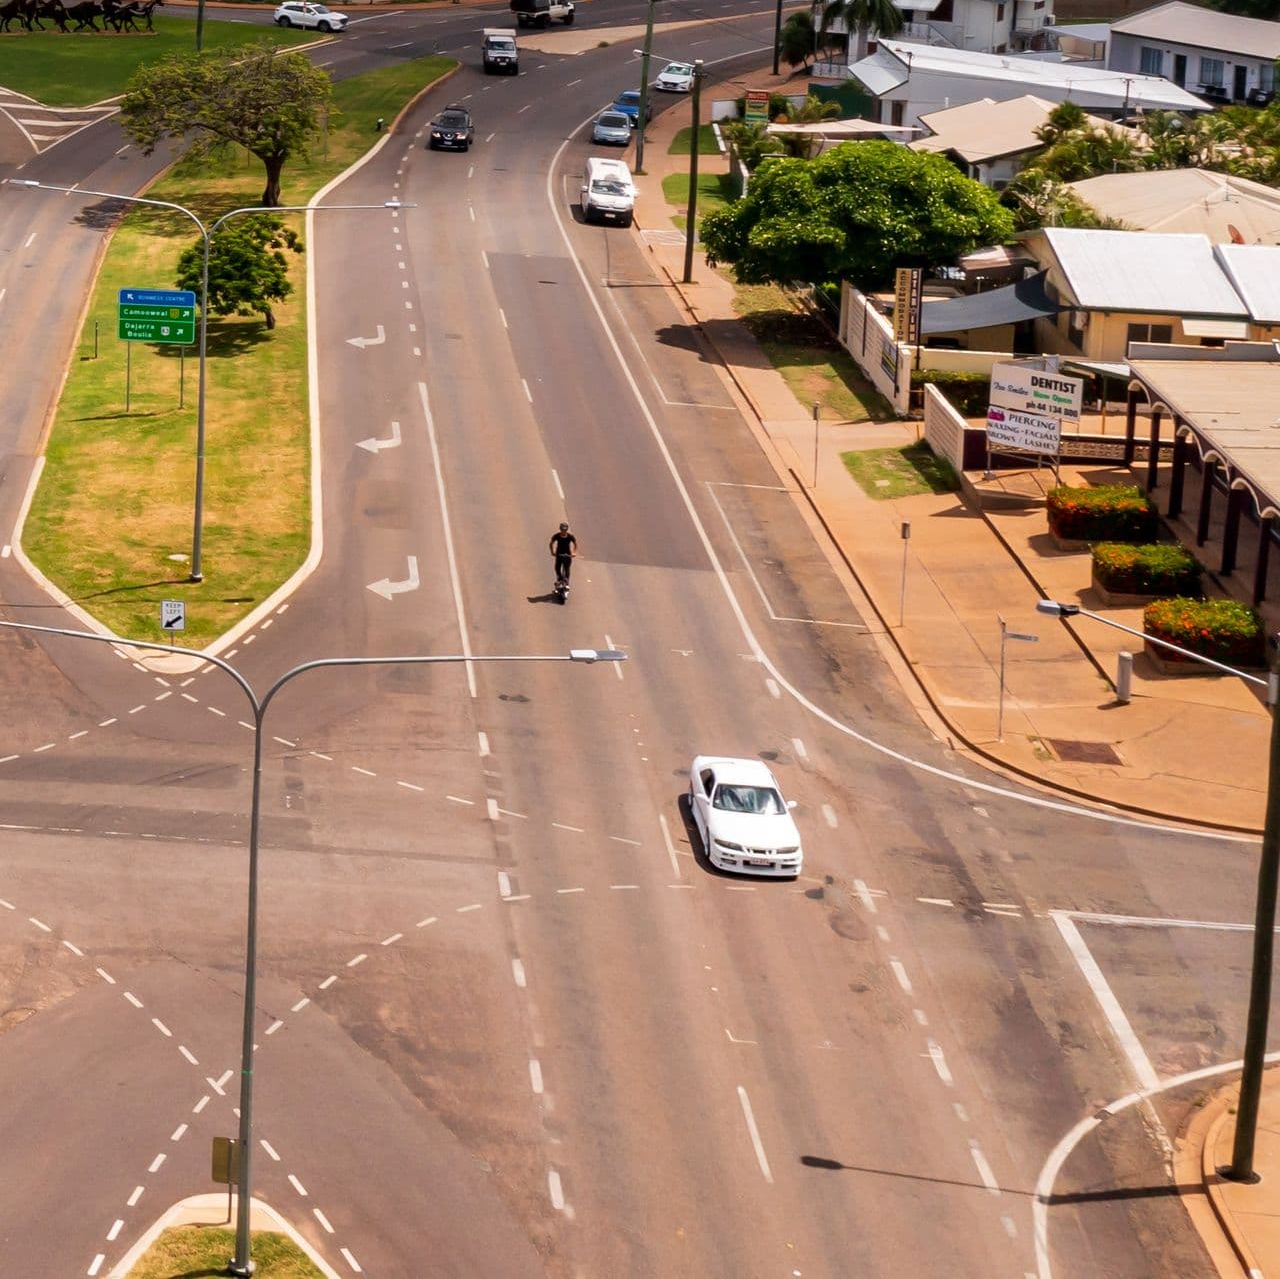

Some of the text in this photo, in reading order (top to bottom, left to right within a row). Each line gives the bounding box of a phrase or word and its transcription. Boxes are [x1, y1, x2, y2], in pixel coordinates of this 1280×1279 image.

[123, 308, 168, 316] Camooweal
[125, 322, 155, 330] Dajarra
[1031, 375, 1077, 394] DENTIST
[1008, 413, 1056, 431] PIERCING
[1025, 428, 1059, 441] FACIALS
[1024, 438, 1056, 451] LASHES
